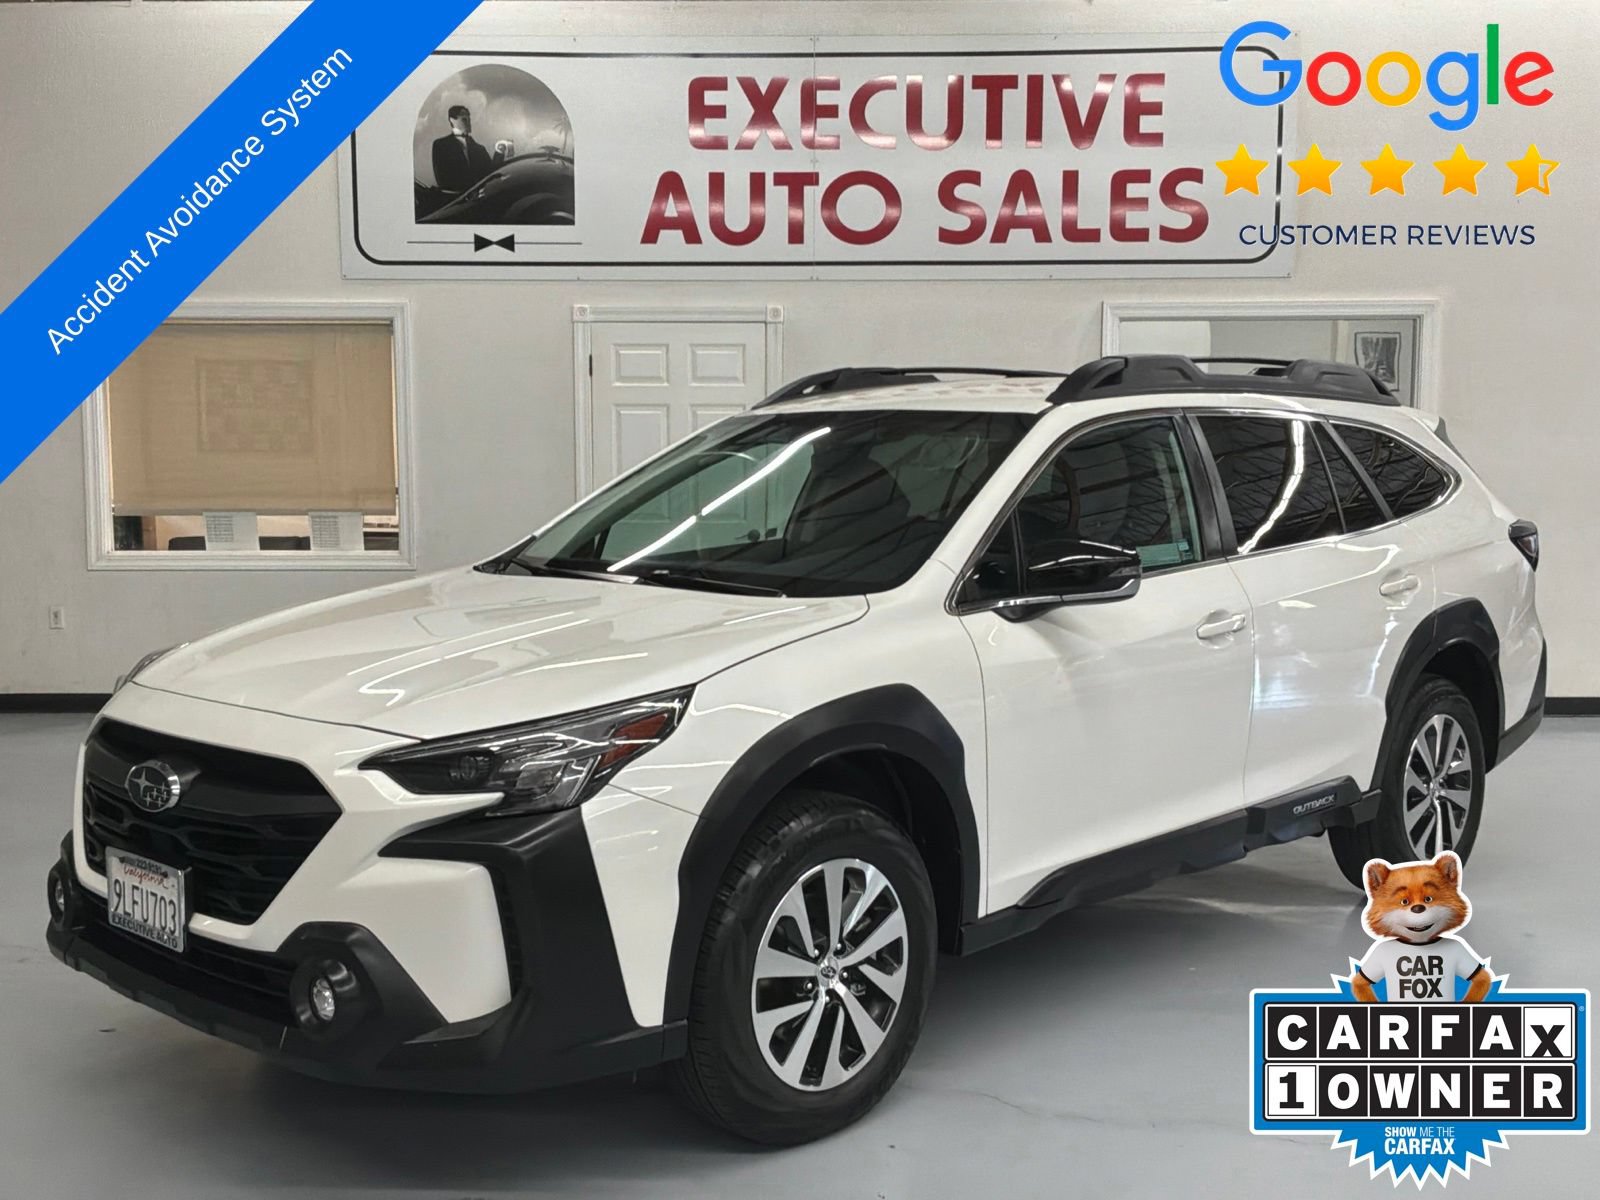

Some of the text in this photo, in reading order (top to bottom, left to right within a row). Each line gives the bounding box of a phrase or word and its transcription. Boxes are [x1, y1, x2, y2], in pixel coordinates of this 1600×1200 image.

[688, 73, 1166, 151] EXECUTIVE
[640, 167, 1209, 246] AUTO SALES
[1293, 794, 1335, 815] OUTBACK
[114, 878, 177, 936] 9LFU703
